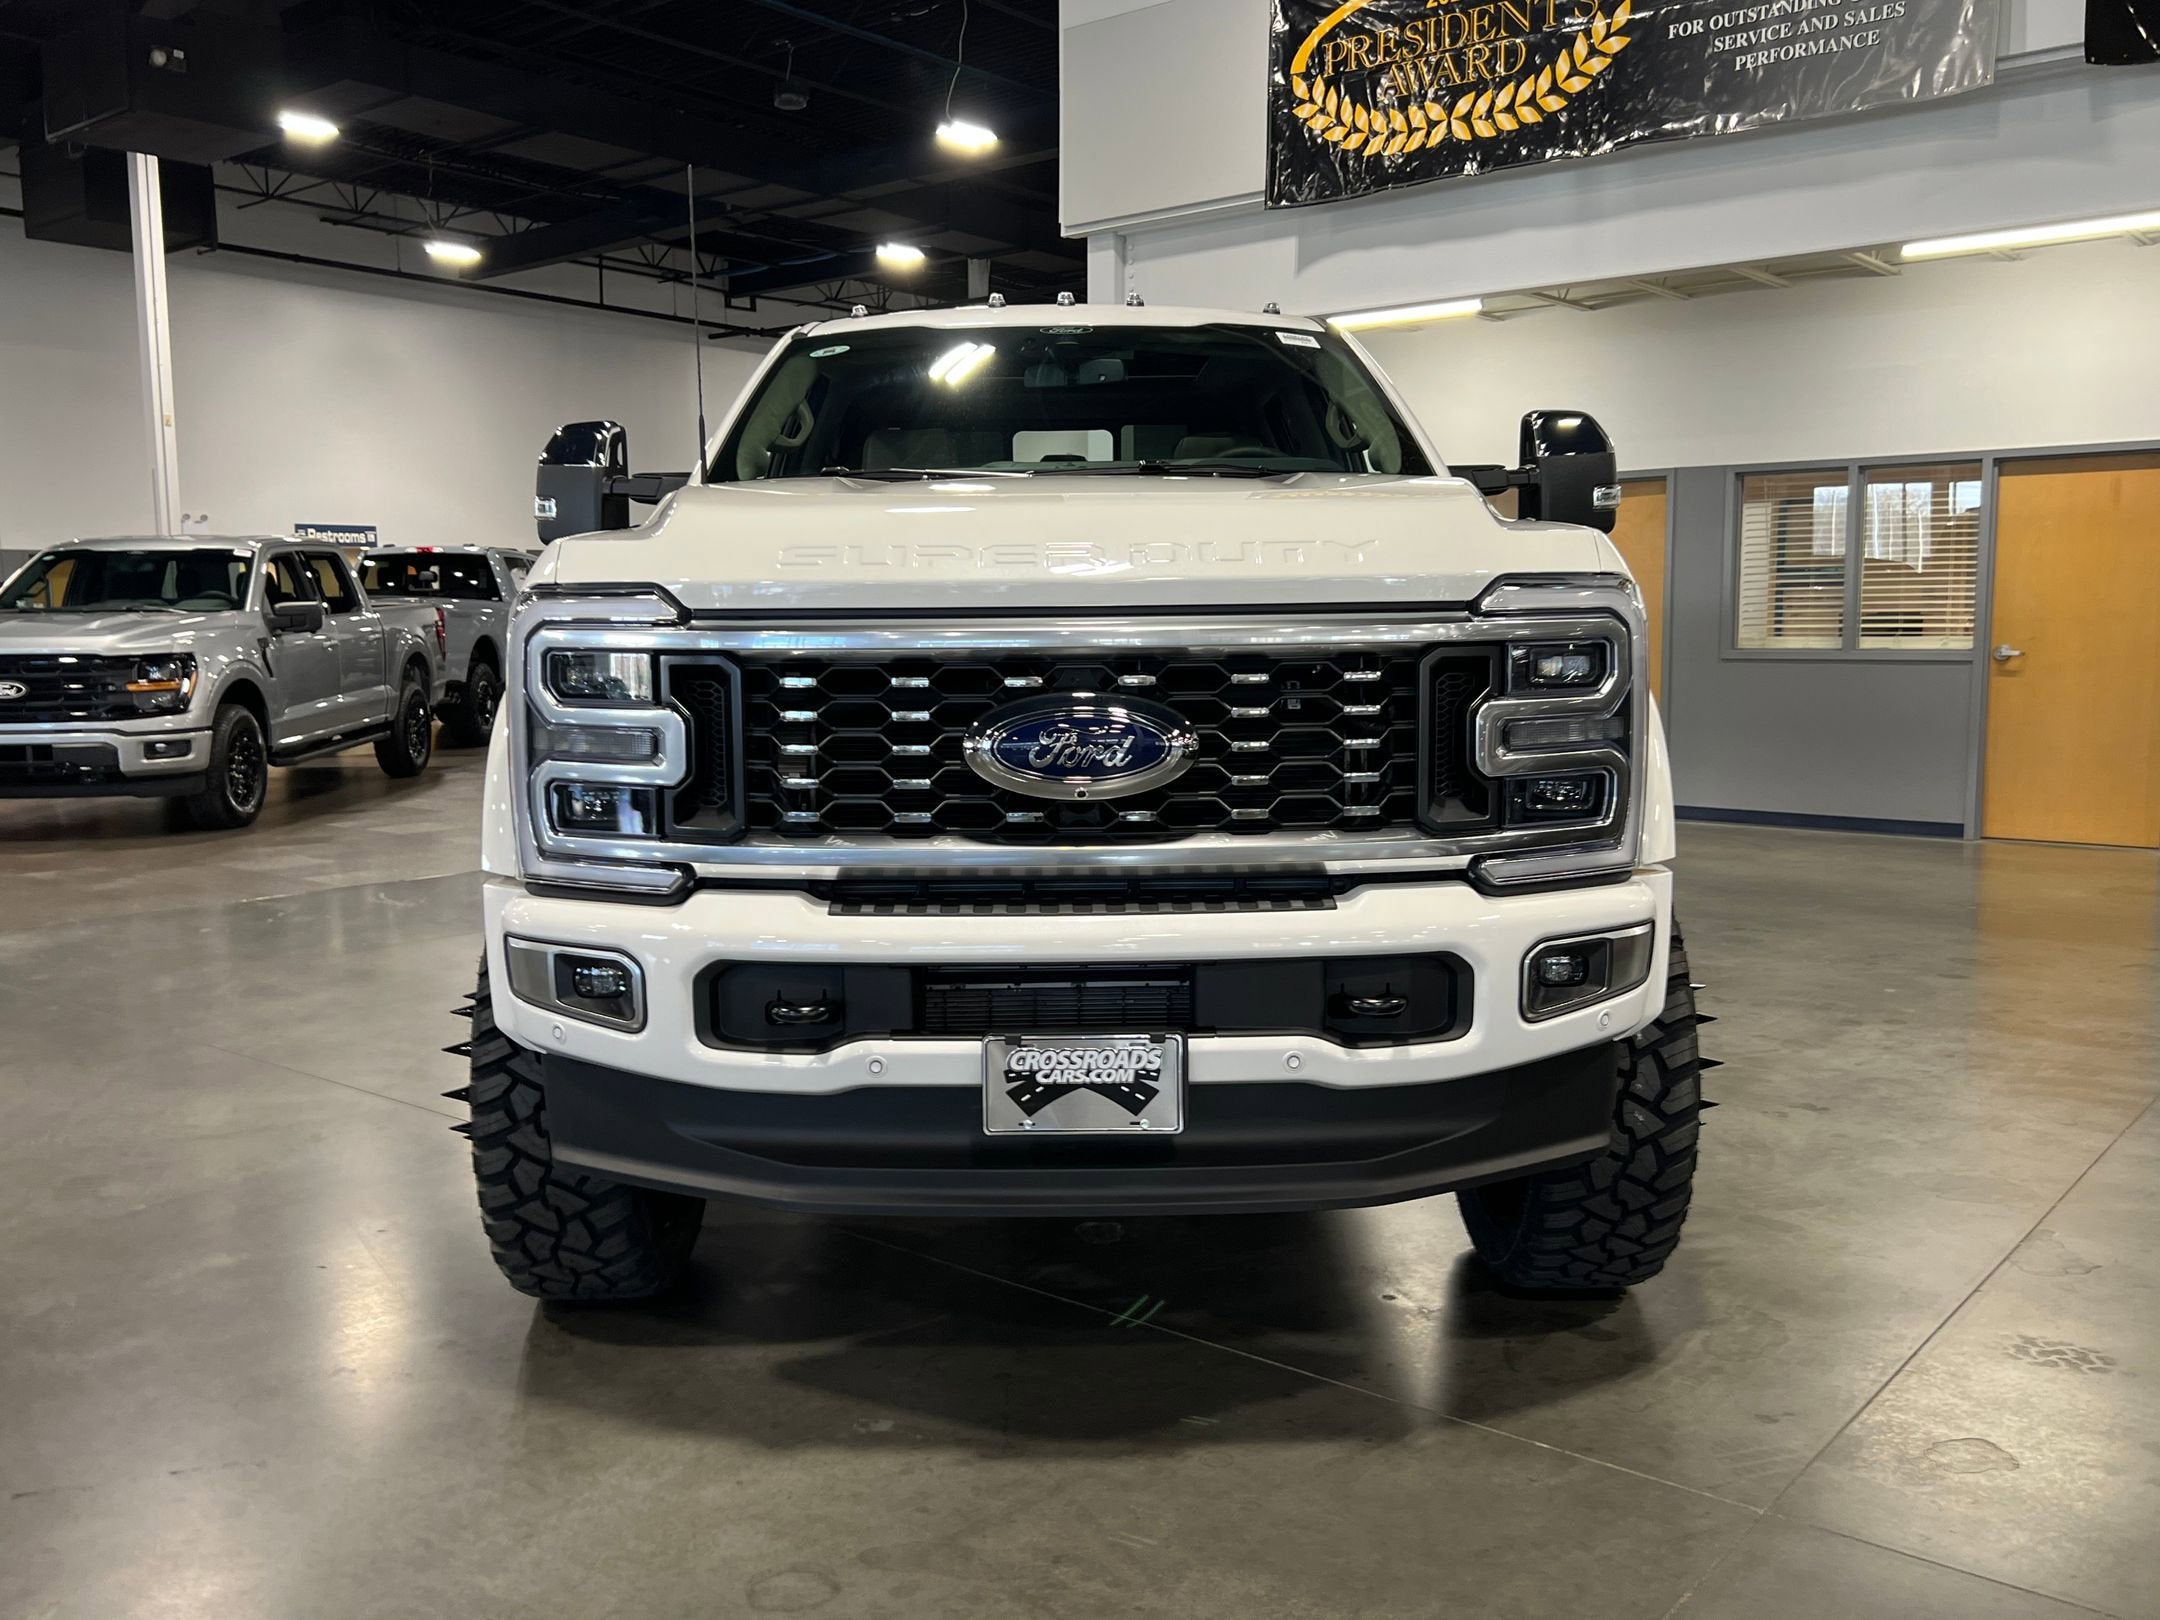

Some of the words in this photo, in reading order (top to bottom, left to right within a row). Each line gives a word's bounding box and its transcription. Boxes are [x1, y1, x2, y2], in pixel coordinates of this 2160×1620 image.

[1667, 18, 1704, 40] FOR
[1713, 22, 1792, 53] SERVICE
[1797, 14, 1839, 35] AND
[1843, 1, 1906, 27] SALES
[1734, 30, 1882, 71] PERFORMANCE
[1380, 38, 1527, 101] AWARD
[307, 528, 367, 544] Restrooms
[775, 541, 1106, 569] SUPER
[1129, 540, 1379, 566] DUTY
[1028, 726, 1136, 768] Ford
[1008, 1048, 1163, 1071] CROSSROADS
[1034, 1068, 1136, 1085] CARS.COM
